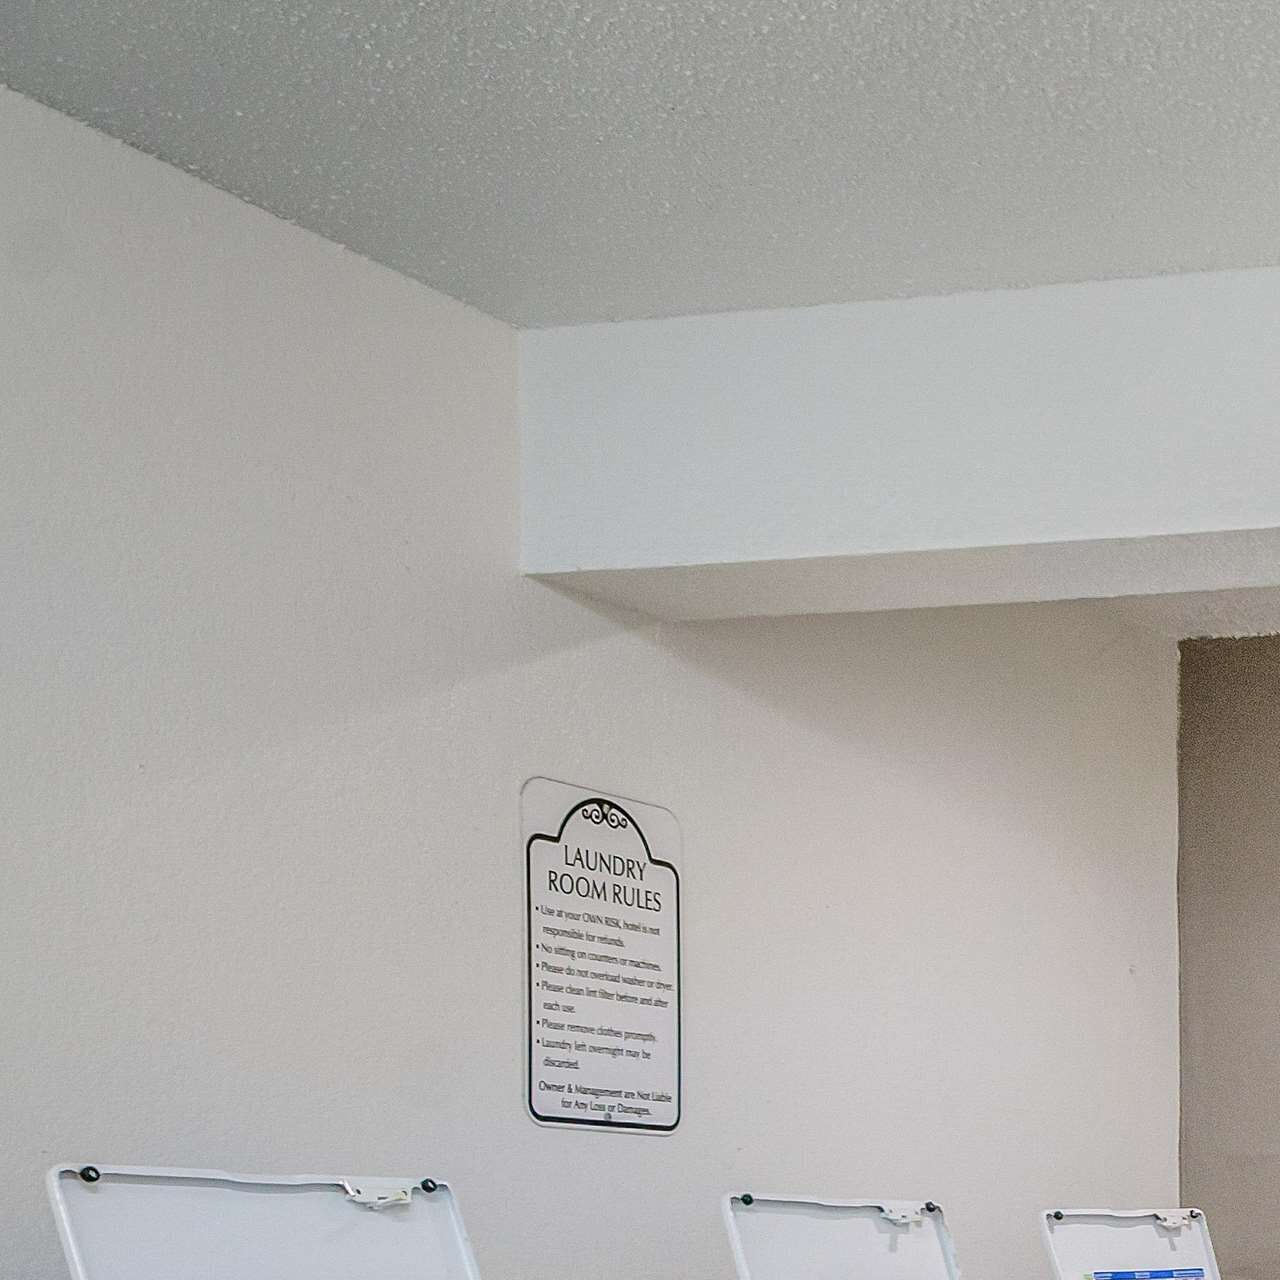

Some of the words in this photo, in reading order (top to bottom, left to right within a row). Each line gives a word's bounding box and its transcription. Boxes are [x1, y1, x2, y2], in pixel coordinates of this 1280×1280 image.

[564, 844, 647, 881] LAUNDRY
[548, 870, 607, 902] ROOM
[612, 883, 662, 912] RULES
[541, 943, 552, 953] No
[538, 1080, 565, 1092] Owner
[567, 1084, 572, 1093] &
